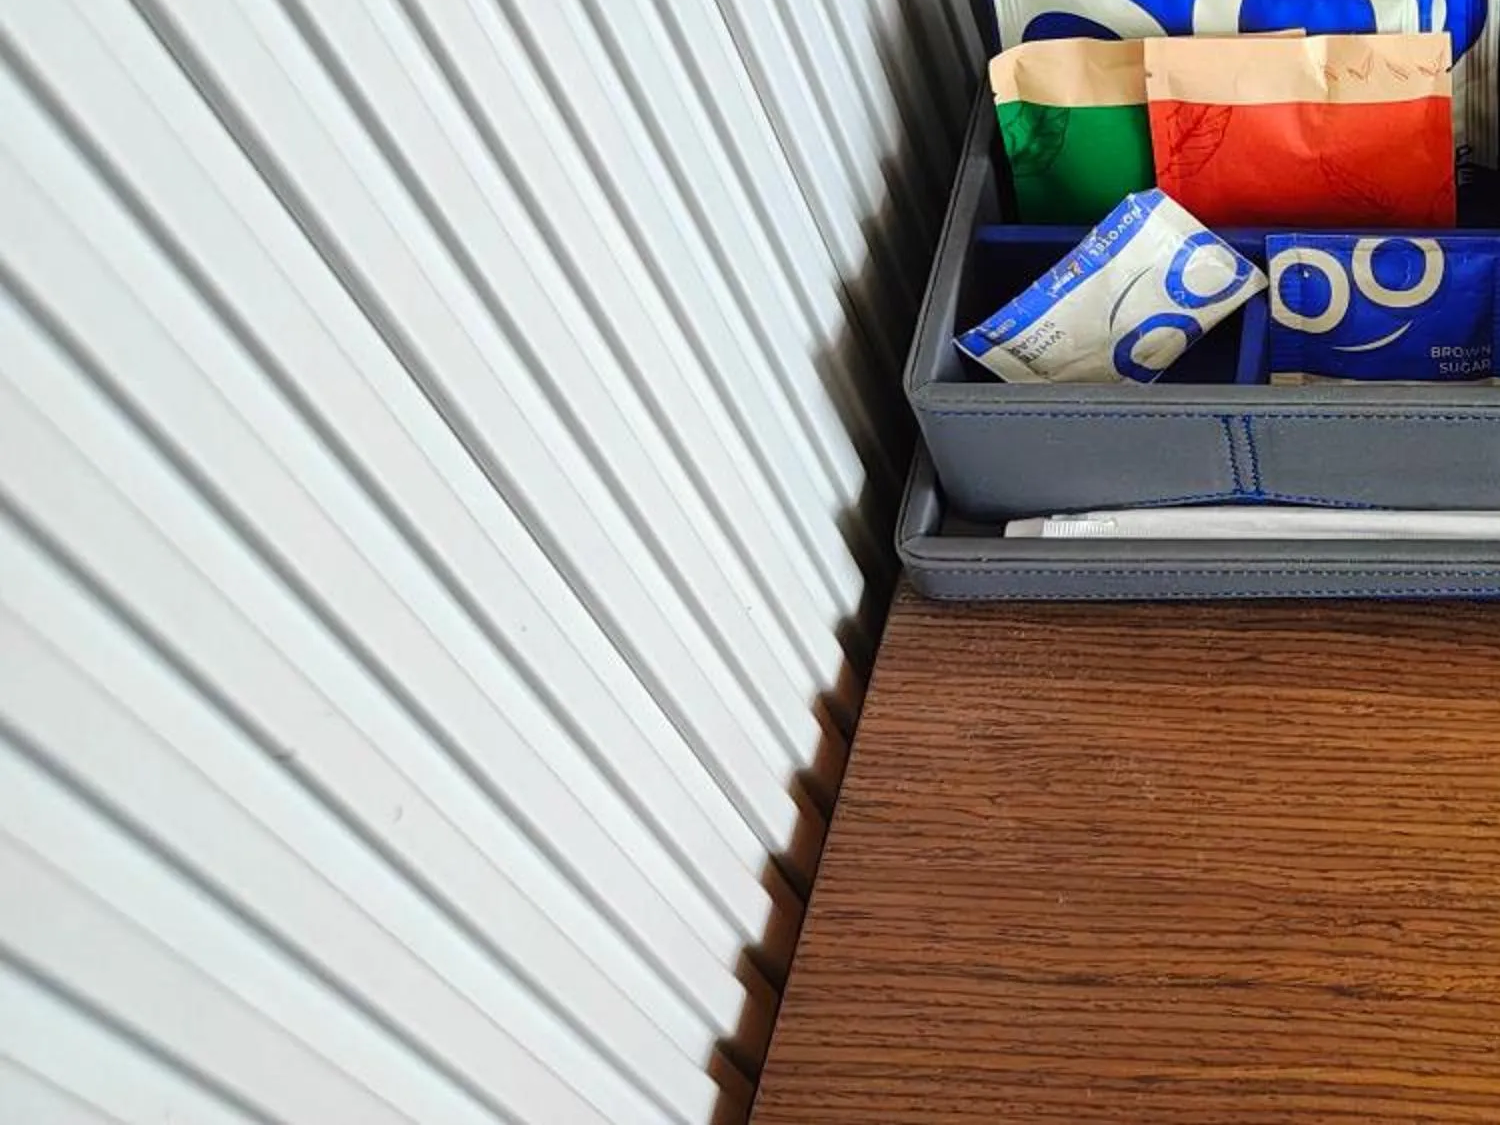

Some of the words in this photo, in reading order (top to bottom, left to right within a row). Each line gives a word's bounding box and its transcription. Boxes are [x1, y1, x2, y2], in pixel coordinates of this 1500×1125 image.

[1089, 202, 1143, 257] NOVOTEL
[1430, 345, 1492, 359] BROWN
[1439, 358, 1491, 374] SUGAR
